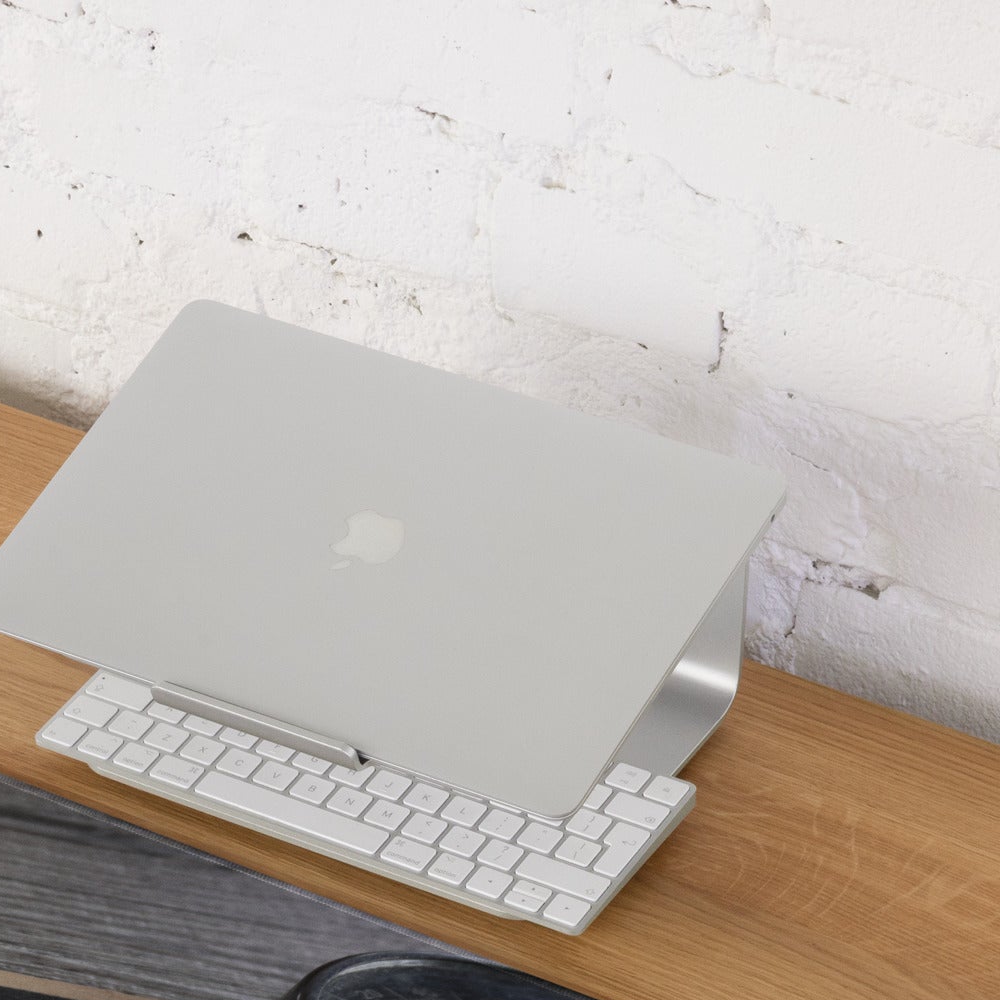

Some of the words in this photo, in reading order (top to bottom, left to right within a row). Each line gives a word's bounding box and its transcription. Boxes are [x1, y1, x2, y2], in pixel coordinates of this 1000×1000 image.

[161, 733, 172, 741] Z
[234, 759, 244, 767] C
[272, 771, 282, 779] V
[308, 785, 318, 793] B
[344, 798, 356, 806] N
[381, 810, 393, 818] M
